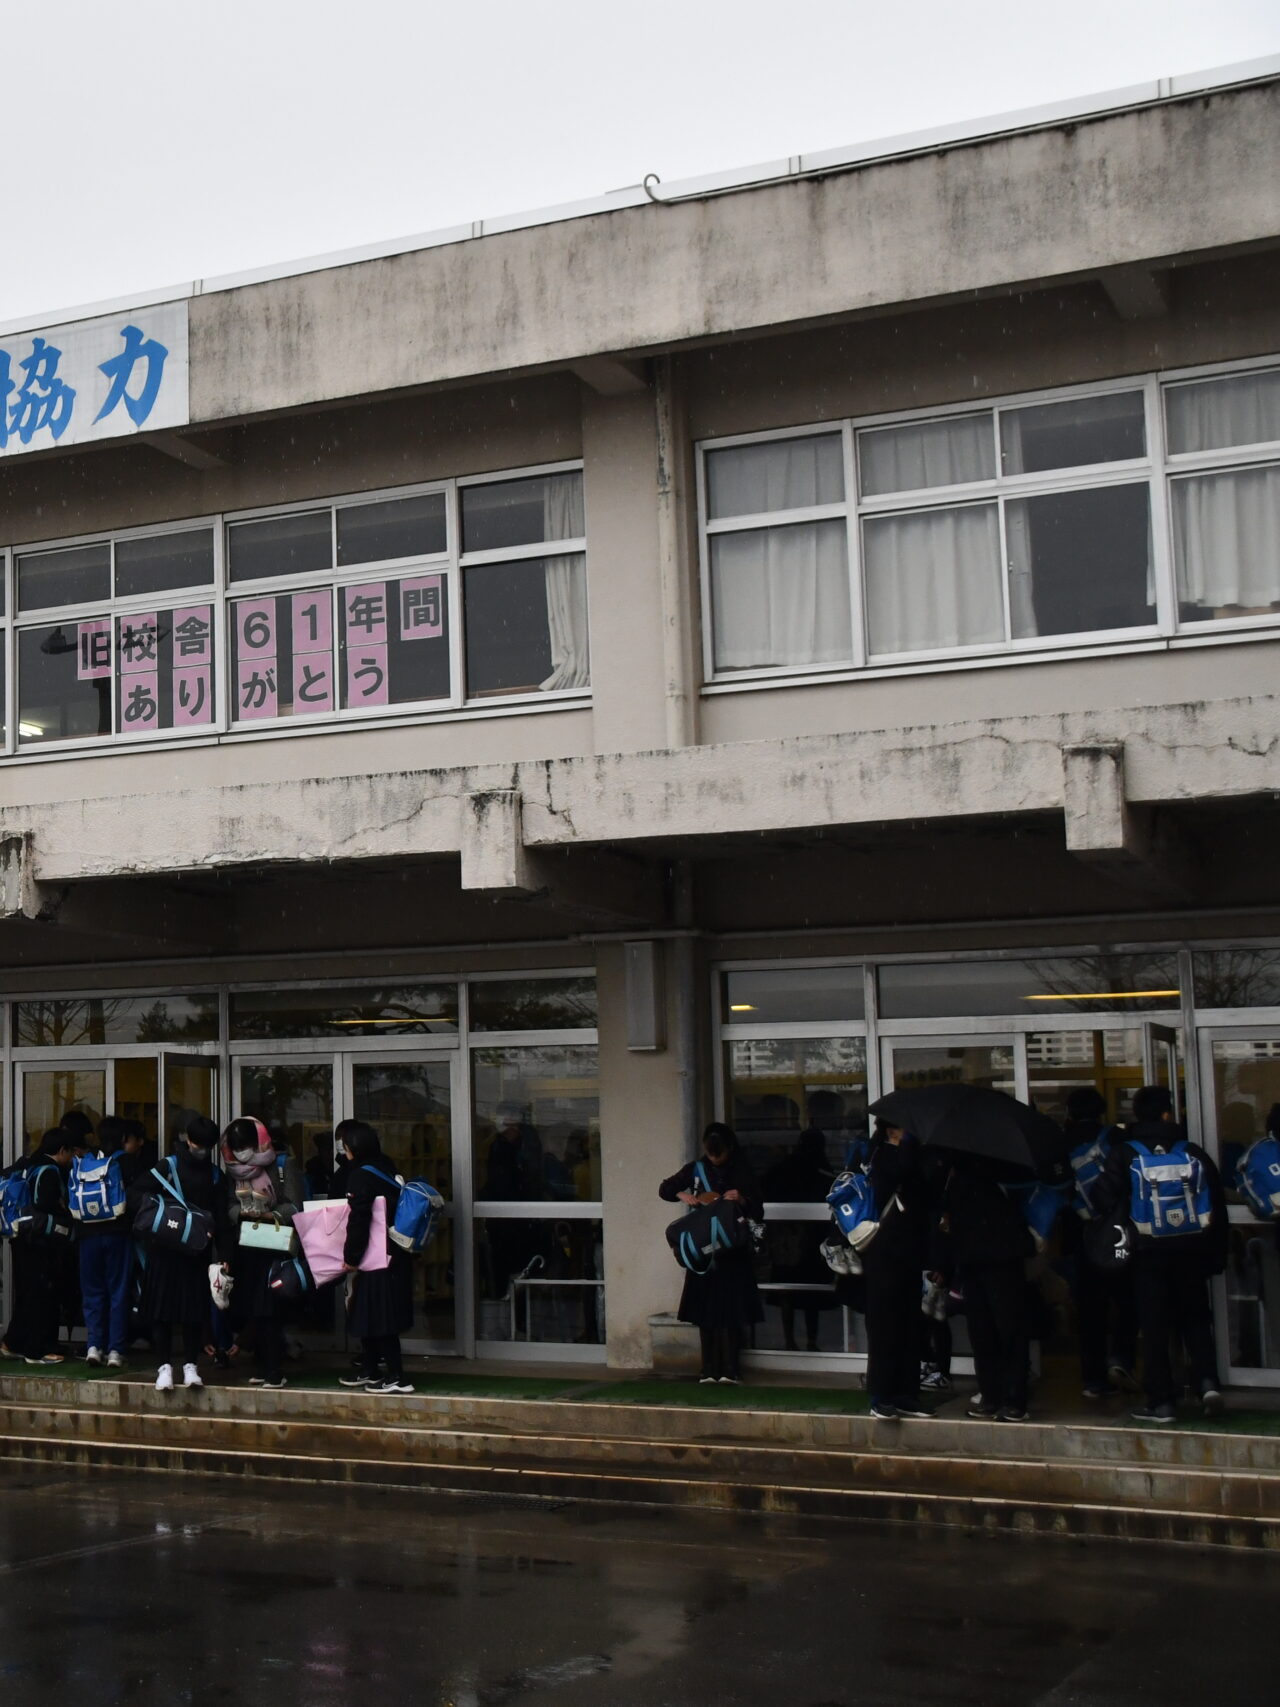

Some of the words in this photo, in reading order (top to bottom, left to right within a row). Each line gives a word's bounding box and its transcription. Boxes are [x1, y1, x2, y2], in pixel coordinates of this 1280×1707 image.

[123, 658, 384, 724] ありがとう
